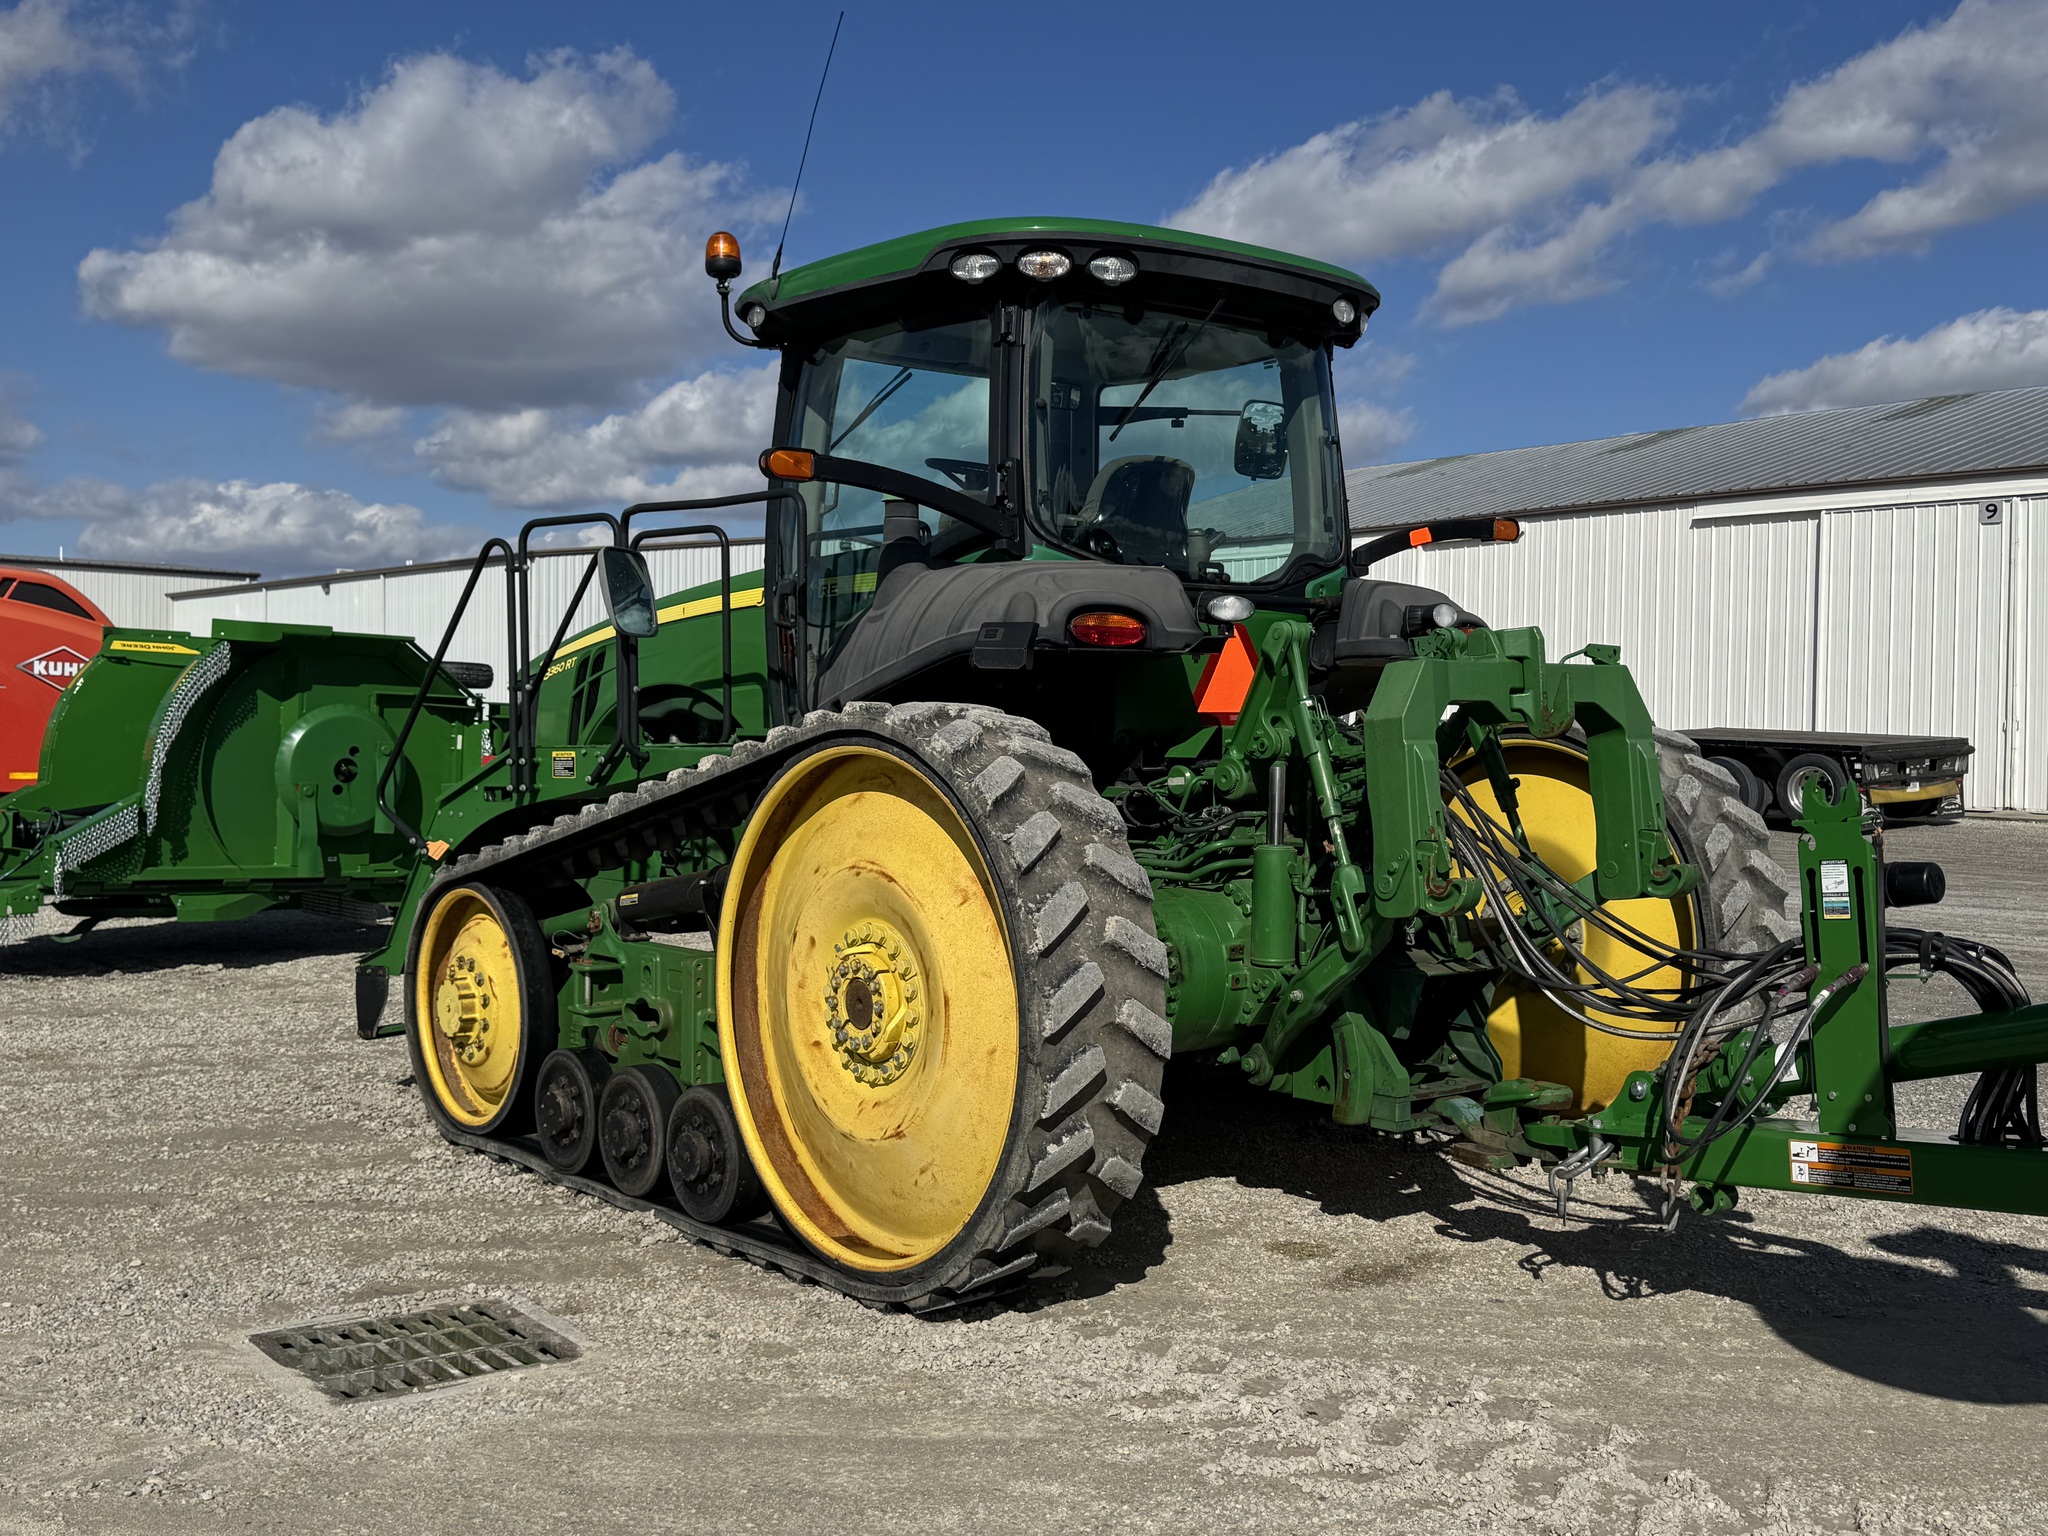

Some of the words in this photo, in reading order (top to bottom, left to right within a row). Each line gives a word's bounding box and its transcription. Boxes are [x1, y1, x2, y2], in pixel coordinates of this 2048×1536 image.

[1985, 503, 1998, 520] 9
[565, 656, 578, 671] RT
[1846, 1145, 1876, 1153] WARNING
